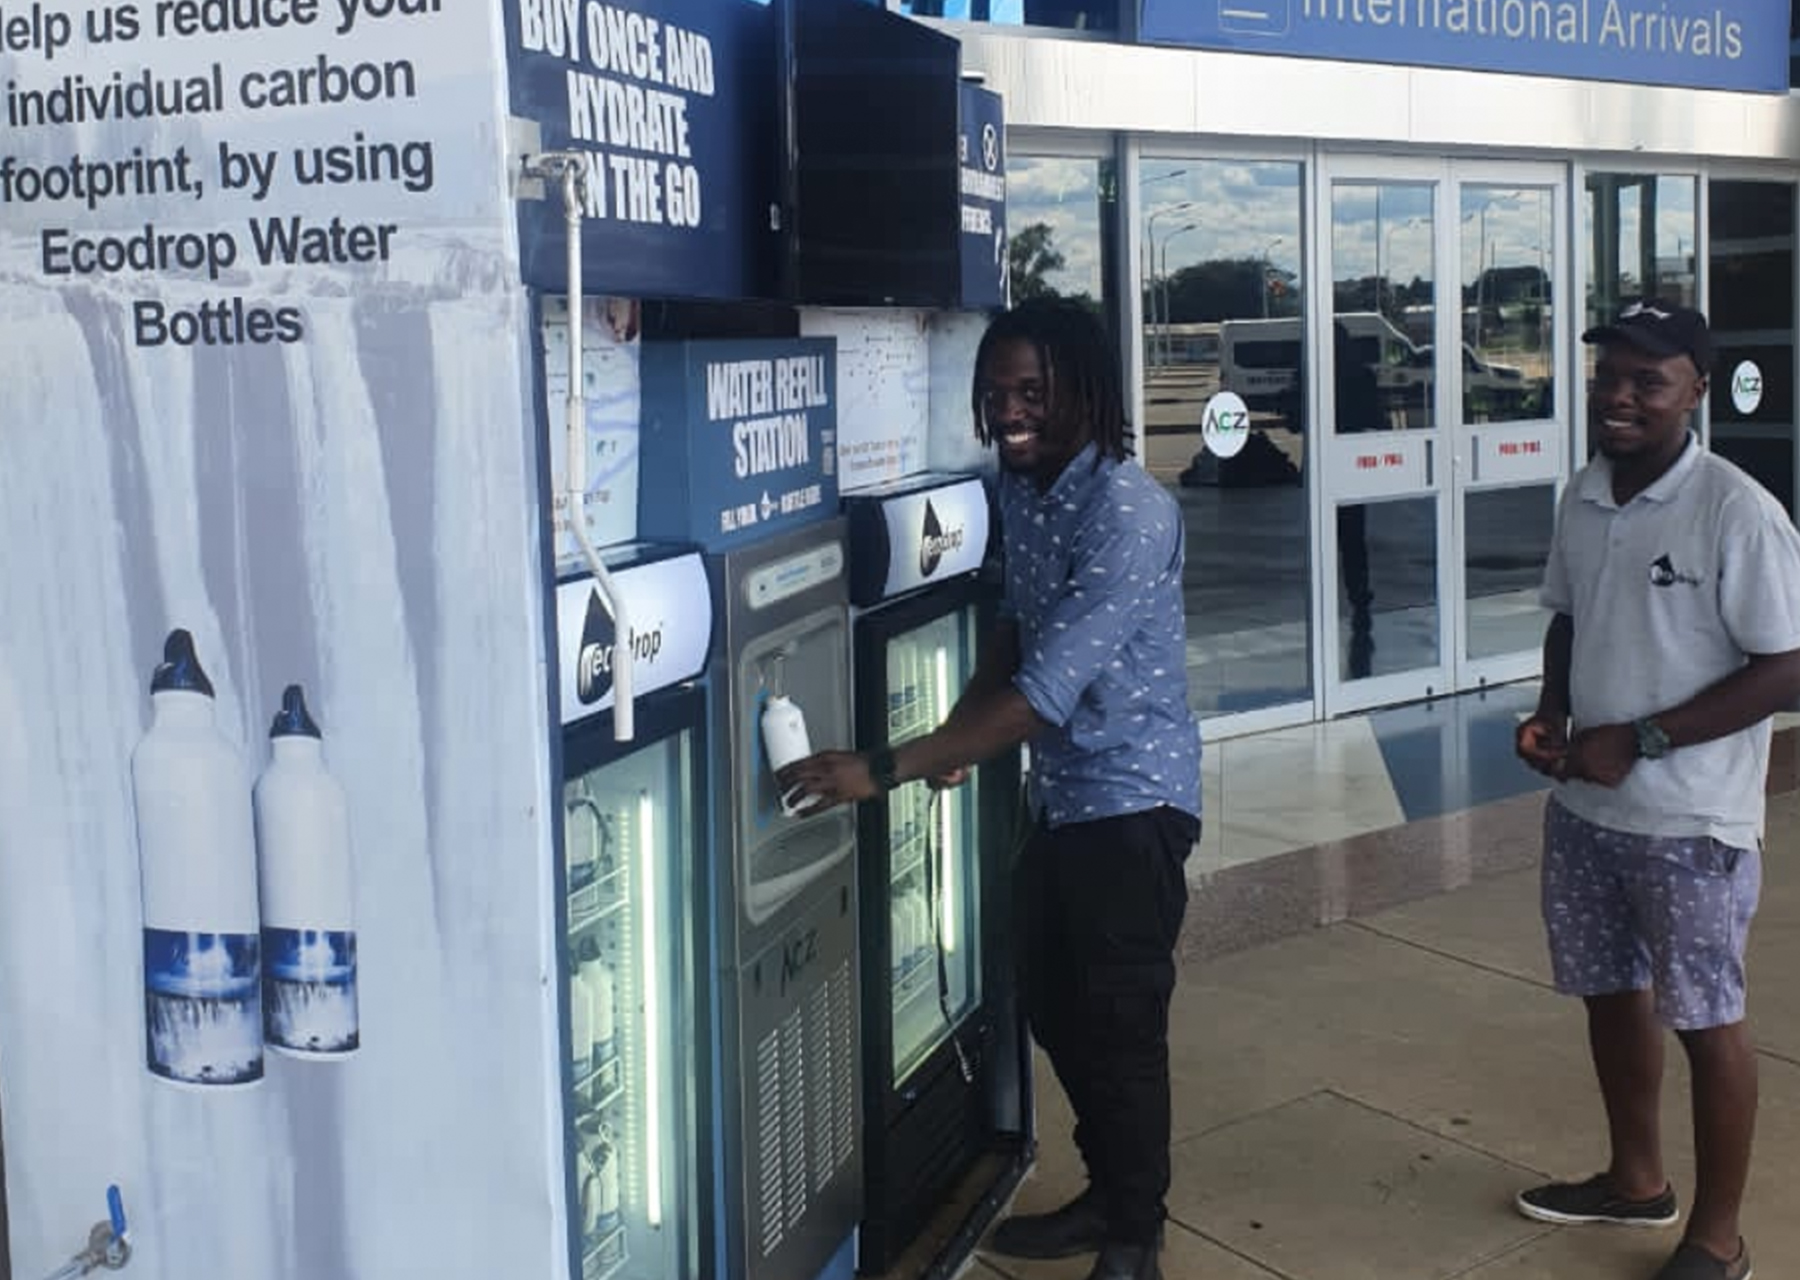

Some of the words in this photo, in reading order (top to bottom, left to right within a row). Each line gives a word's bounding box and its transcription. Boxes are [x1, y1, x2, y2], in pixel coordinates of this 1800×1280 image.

[0, 2, 71, 60] elp
[86, 5, 140, 43] us
[155, 0, 319, 37] reduce
[519, 0, 581, 62] BUY
[586, 1, 664, 83] ONCE
[665, 24, 715, 97] AND
[1600, 0, 1742, 58] Arrivals
[7, 63, 224, 127] individual
[239, 54, 416, 109] carbon
[567, 70, 692, 158] HYDRATE
[0, 145, 204, 210] footprint,
[218, 142, 277, 200] by
[293, 132, 435, 192] using
[609, 154, 663, 223] THE
[666, 162, 701, 228] GO
[41, 225, 237, 280] Ecodrop
[249, 216, 398, 266] Water
[133, 297, 304, 347] Bottles
[707, 360, 774, 421] WATER
[776, 355, 828, 411] REFILL
[1206, 408, 1247, 433] ACZ
[733, 412, 809, 479] STATION
